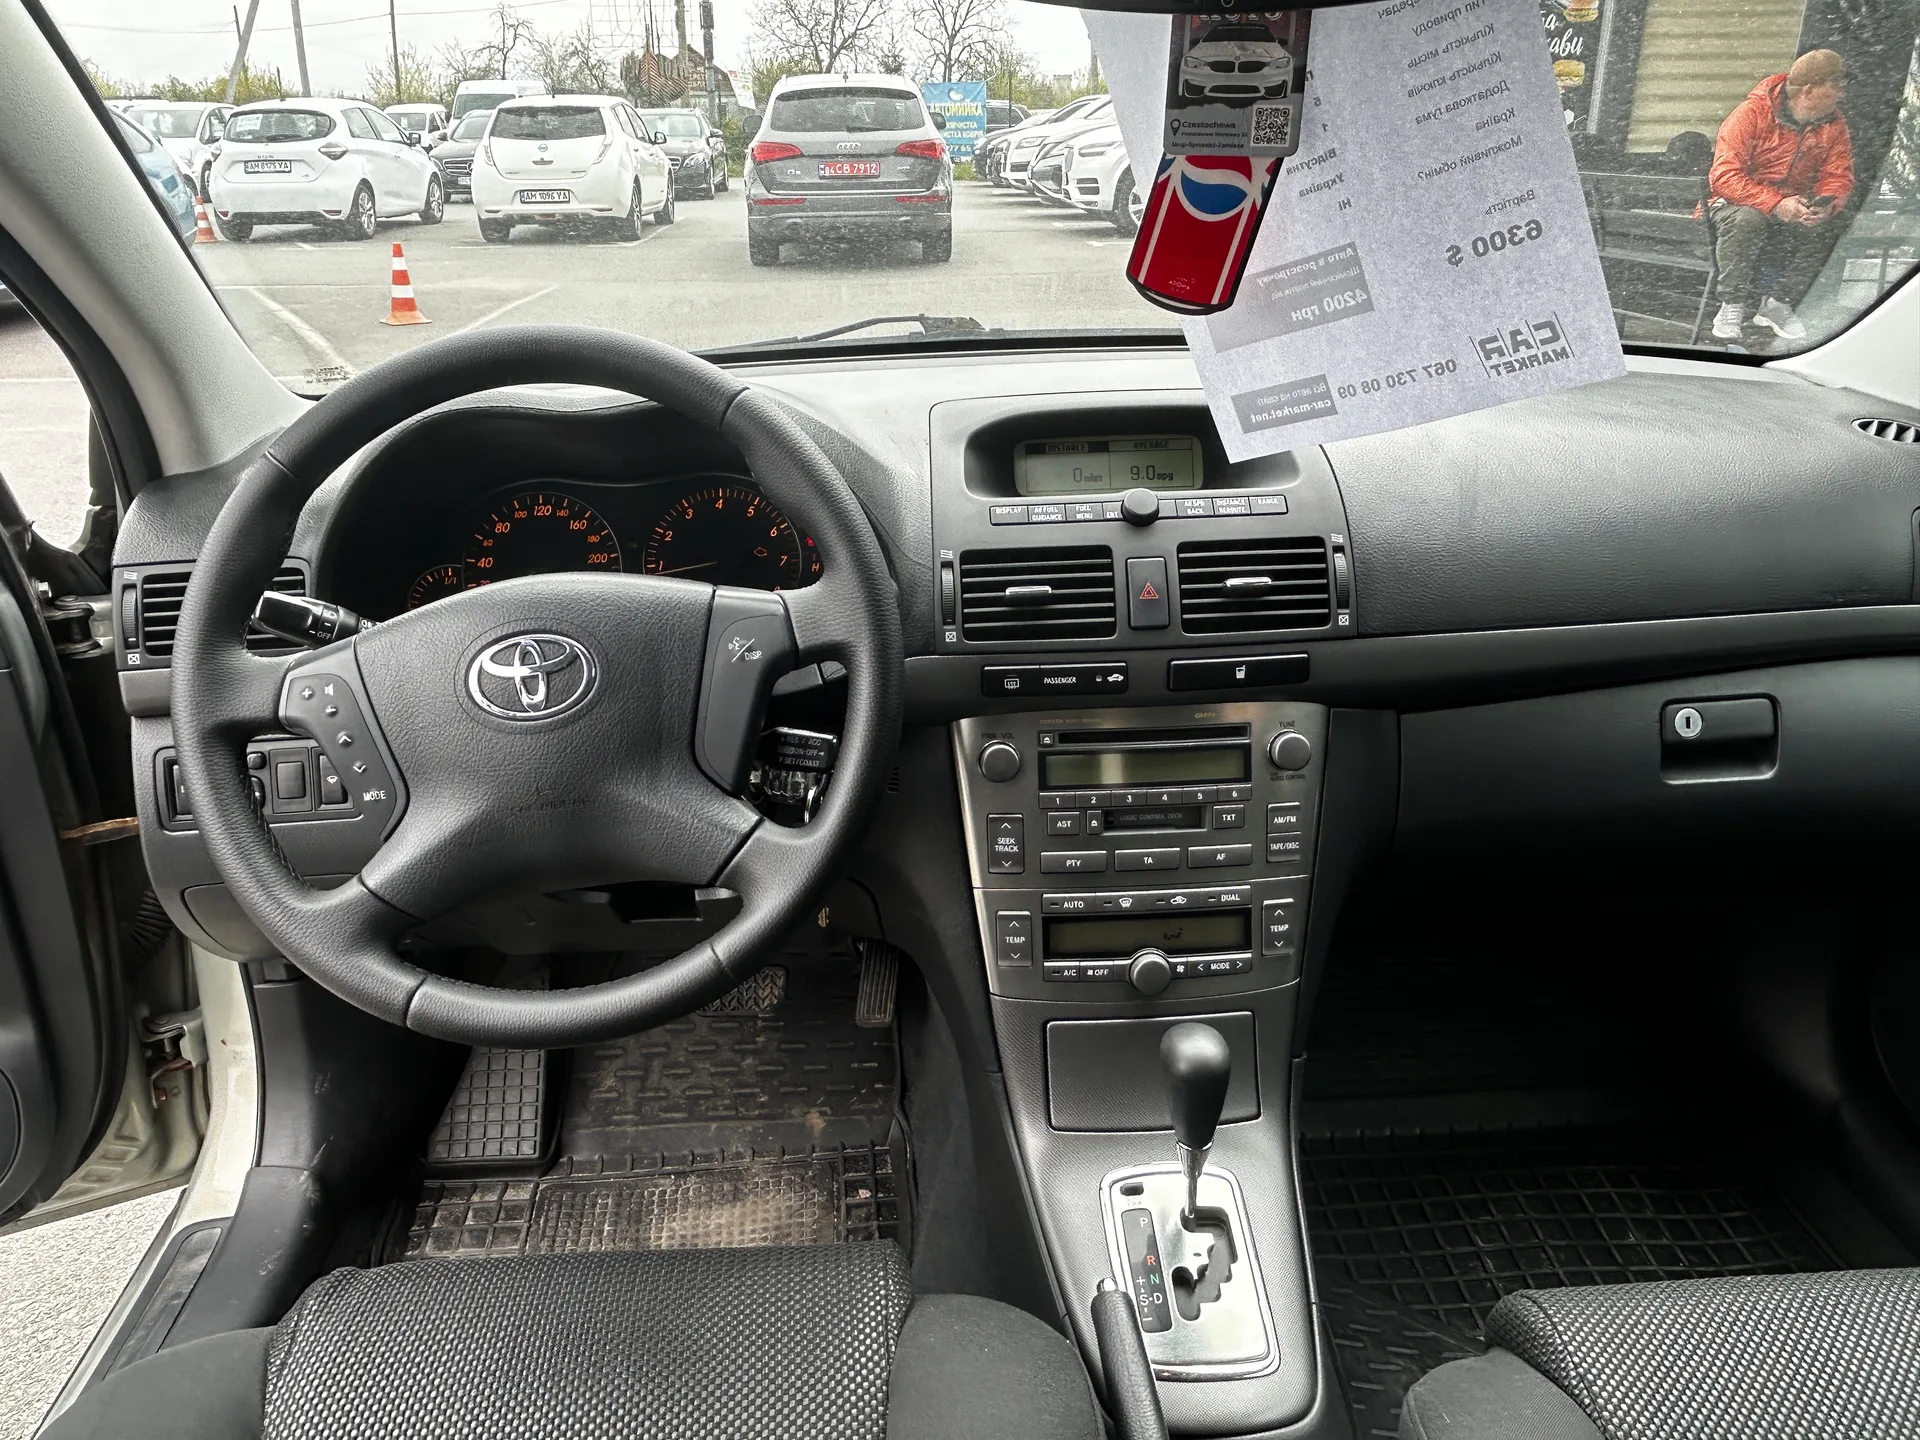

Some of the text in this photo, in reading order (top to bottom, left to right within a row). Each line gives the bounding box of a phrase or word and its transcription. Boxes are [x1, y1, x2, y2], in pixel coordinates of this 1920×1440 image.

[1547, 28, 1584, 57] ави
[853, 163, 877, 174] 7912
[525, 191, 568, 201] AM 1096 YA
[1133, 440, 1170, 450] AVERAGE
[715, 499, 724, 510] 4
[533, 505, 553, 517] 120
[685, 509, 694, 520] 3
[747, 506, 755, 517] 5
[494, 522, 511, 534] 80
[569, 519, 588, 531] 160
[664, 531, 673, 542] 2
[769, 526, 778, 538] 6
[477, 557, 494, 569] 40
[587, 553, 609, 565] 200
[779, 555, 788, 567] 7
[316, 630, 333, 640] OFF
[1043, 676, 1077, 685] PASSENGER
[1278, 720, 1296, 729] TUNE
[362, 790, 387, 802] MODE
[1161, 793, 1169, 802] 4
[1197, 792, 1204, 800] 5
[1231, 790, 1239, 798] 6
[1090, 796, 1097, 804] 2
[1126, 795, 1133, 803] 3
[1222, 813, 1237, 821] TXT
[1273, 815, 1297, 824] AM/FM
[1056, 820, 1072, 828] AST
[997, 837, 1016, 845] SEEK
[994, 844, 1019, 853] TRACK
[1270, 841, 1300, 851] TAPE/DISC
[1143, 856, 1154, 864] TA
[1215, 853, 1227, 861] AF
[1066, 859, 1082, 868] PTY
[1220, 893, 1241, 902] DUAL
[1063, 900, 1085, 909] AUTO
[1269, 924, 1290, 933] TEMP
[1005, 936, 1026, 944] TEMP
[1210, 961, 1231, 970] MODE
[1063, 969, 1077, 977] A/C
[1094, 968, 1110, 976] OFF
[1140, 1217, 1149, 1228] P
[1146, 1255, 1157, 1266] R
[1150, 1273, 1160, 1285] N
